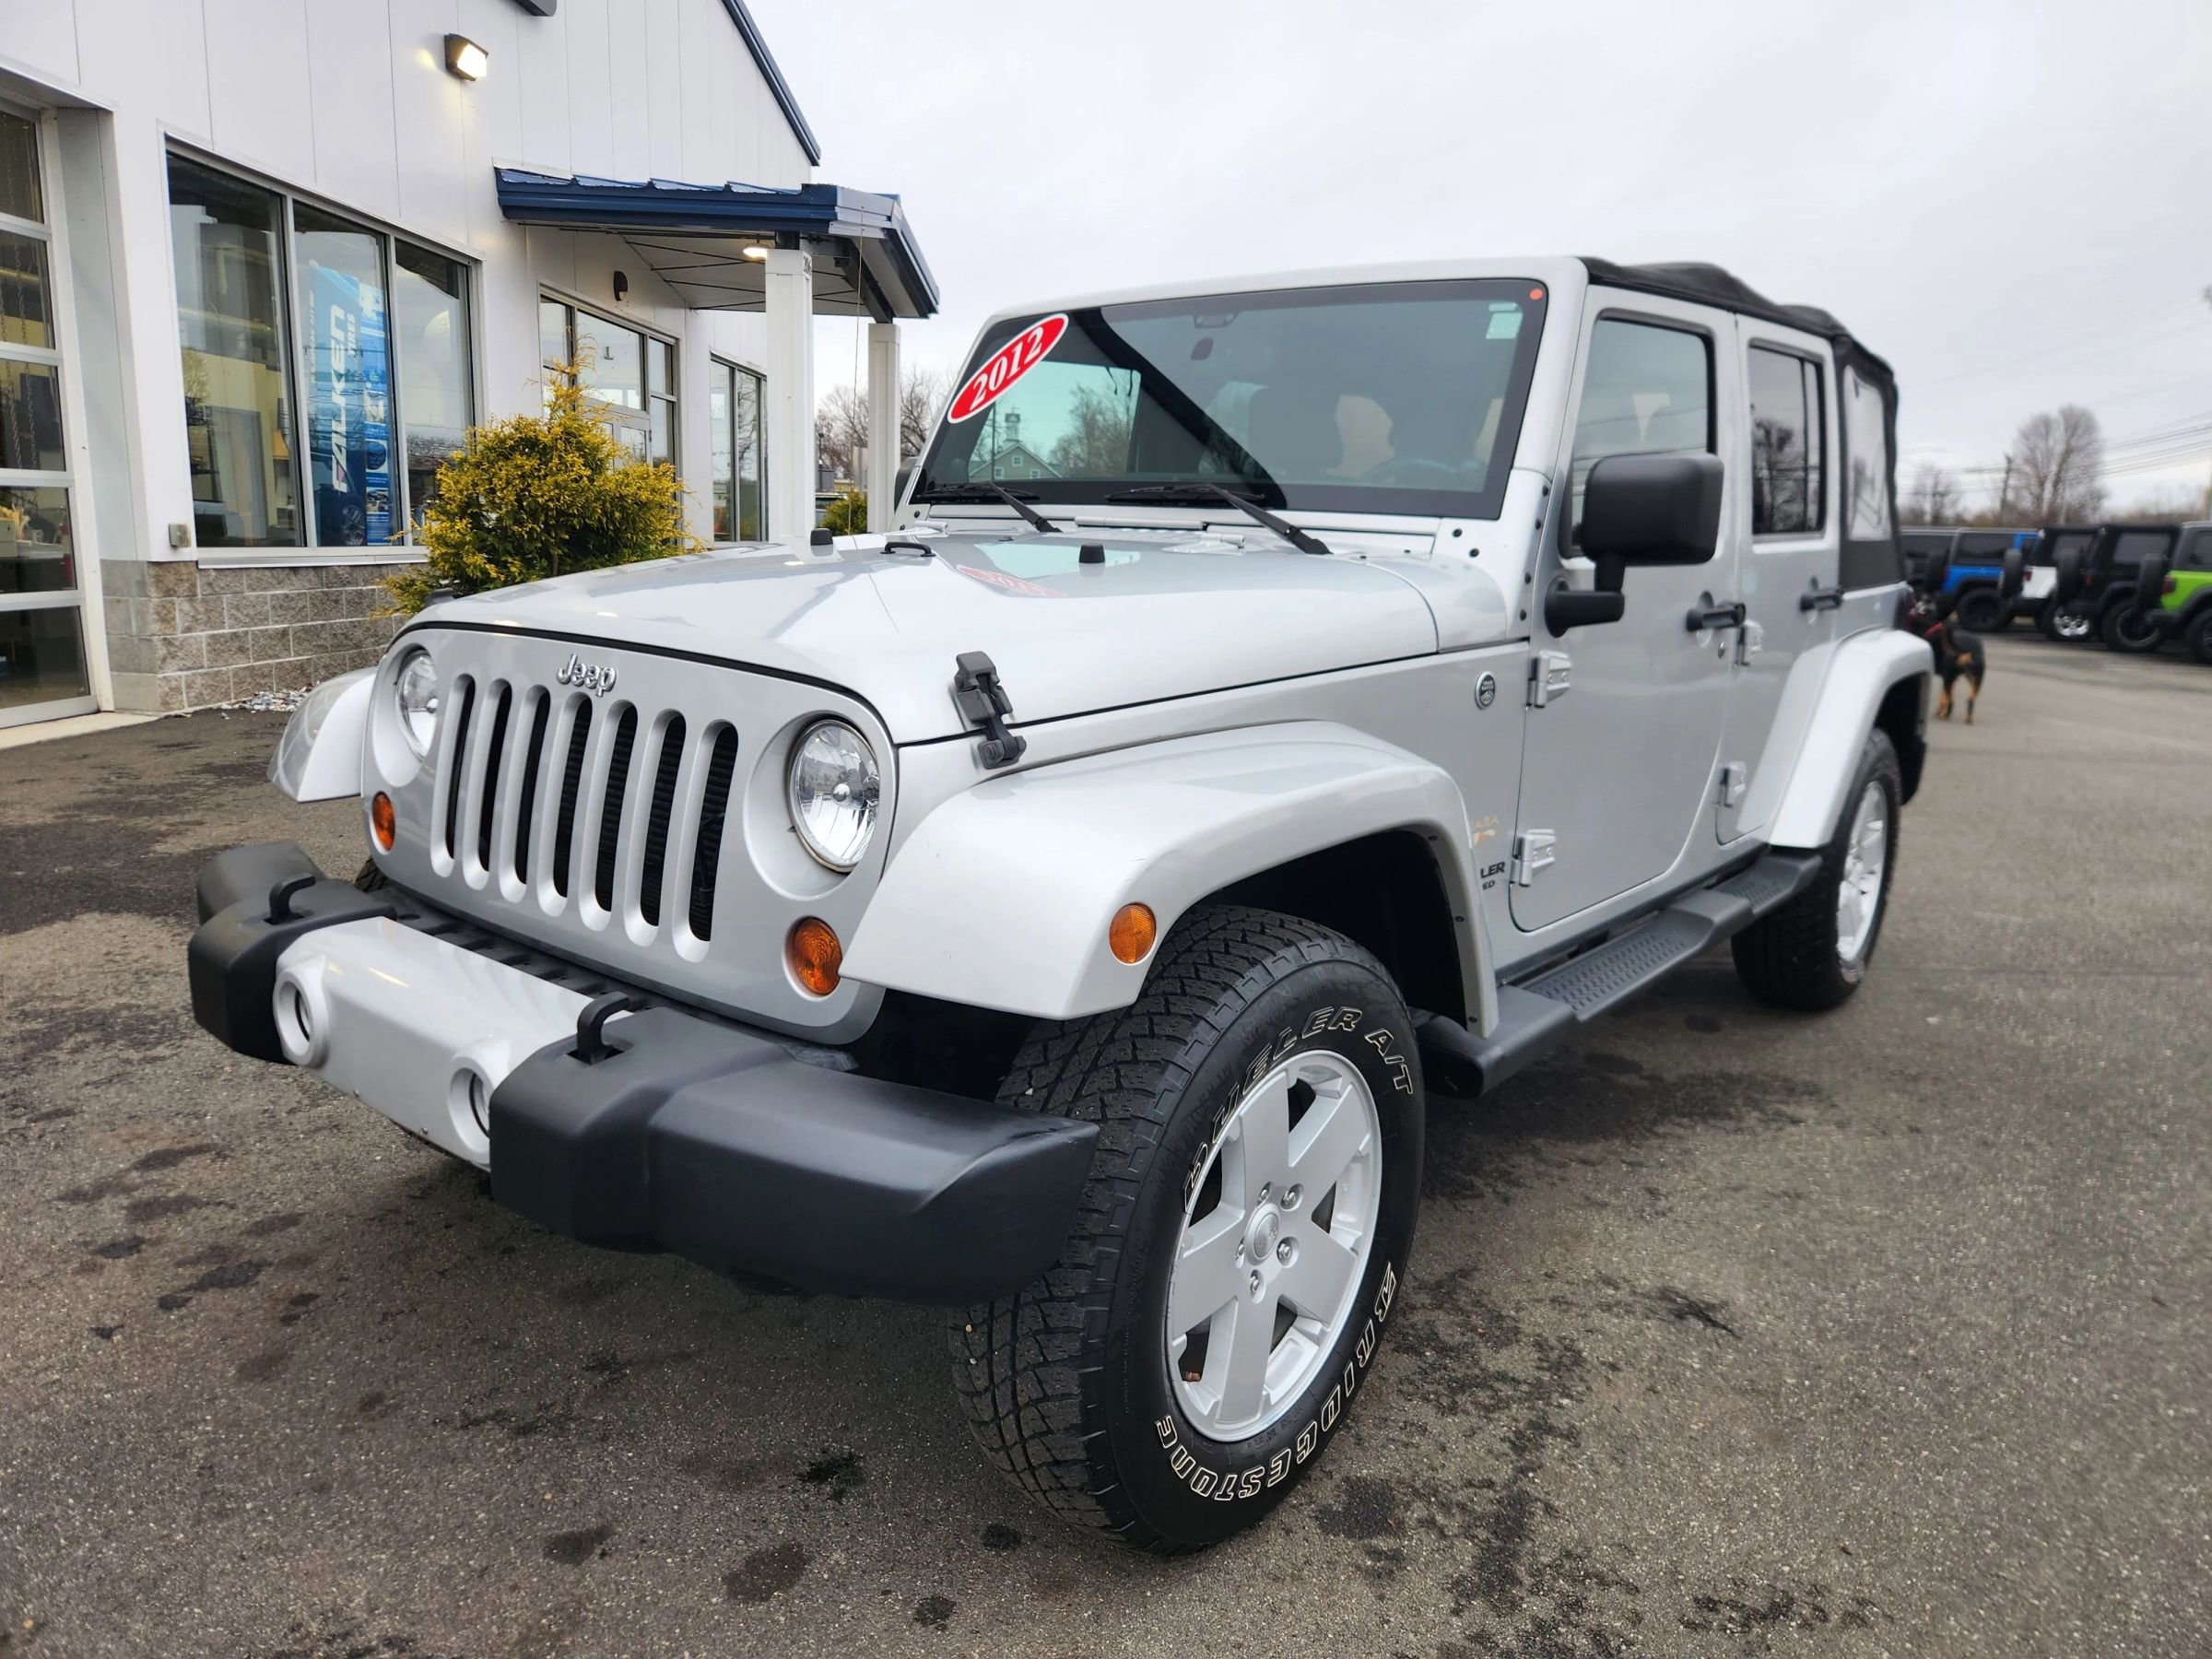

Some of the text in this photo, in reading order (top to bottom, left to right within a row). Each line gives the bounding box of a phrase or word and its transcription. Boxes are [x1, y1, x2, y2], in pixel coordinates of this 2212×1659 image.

[347, 312, 357, 356] TIRES
[969, 325, 1044, 412] 2012
[331, 304, 348, 493] FALKEN
[556, 653, 617, 698] Jeep
[1154, 1261, 1397, 1501] BRIDGESTONE
